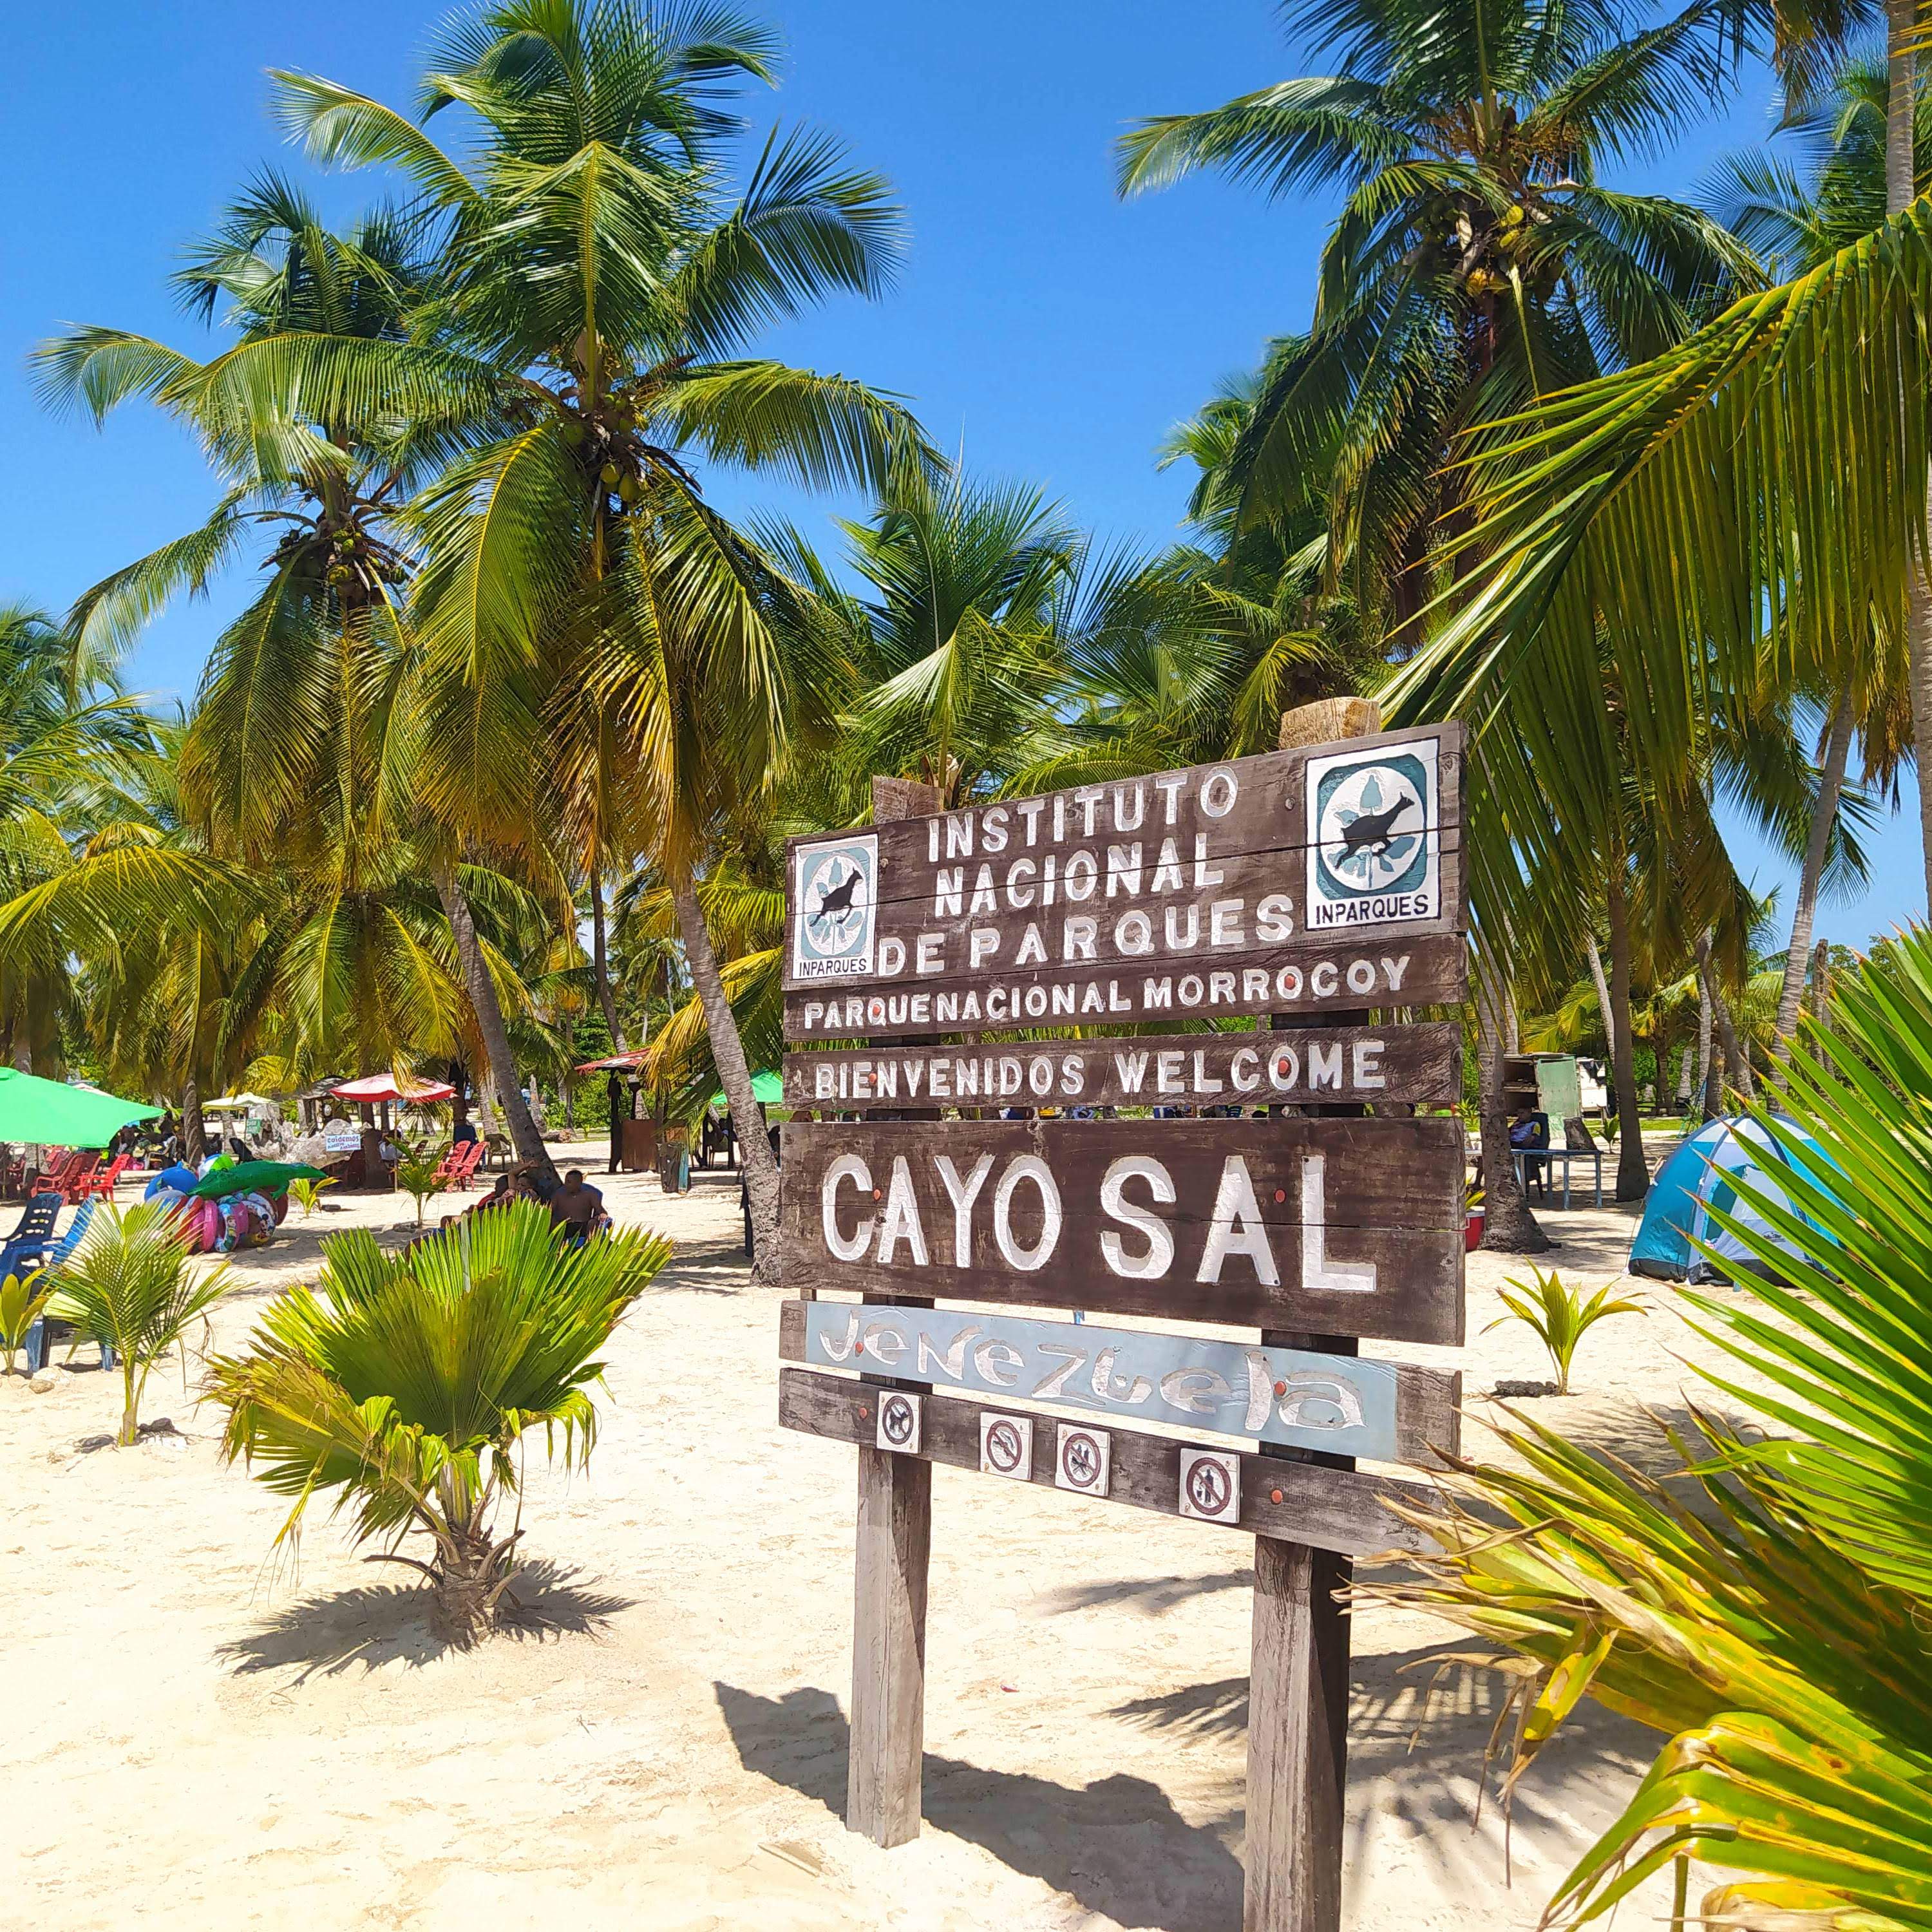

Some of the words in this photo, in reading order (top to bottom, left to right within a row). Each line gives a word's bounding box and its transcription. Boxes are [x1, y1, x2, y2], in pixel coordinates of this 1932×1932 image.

[928, 766, 1238, 863] INSTITUTO
[934, 833, 1224, 919] NACIONAL
[1316, 894, 1429, 925] INPARQUES
[799, 957, 867, 977] INPARQUES
[878, 933, 947, 976] DE
[970, 894, 1294, 969] PARQUES
[1143, 956, 1410, 1009] MORROCOY
[815, 1054, 1084, 1099] BIENVENIDOS
[1115, 1041, 1385, 1093] WELCOME
[821, 1153, 1063, 1271] CAYO
[1099, 1155, 1377, 1292] SAL
